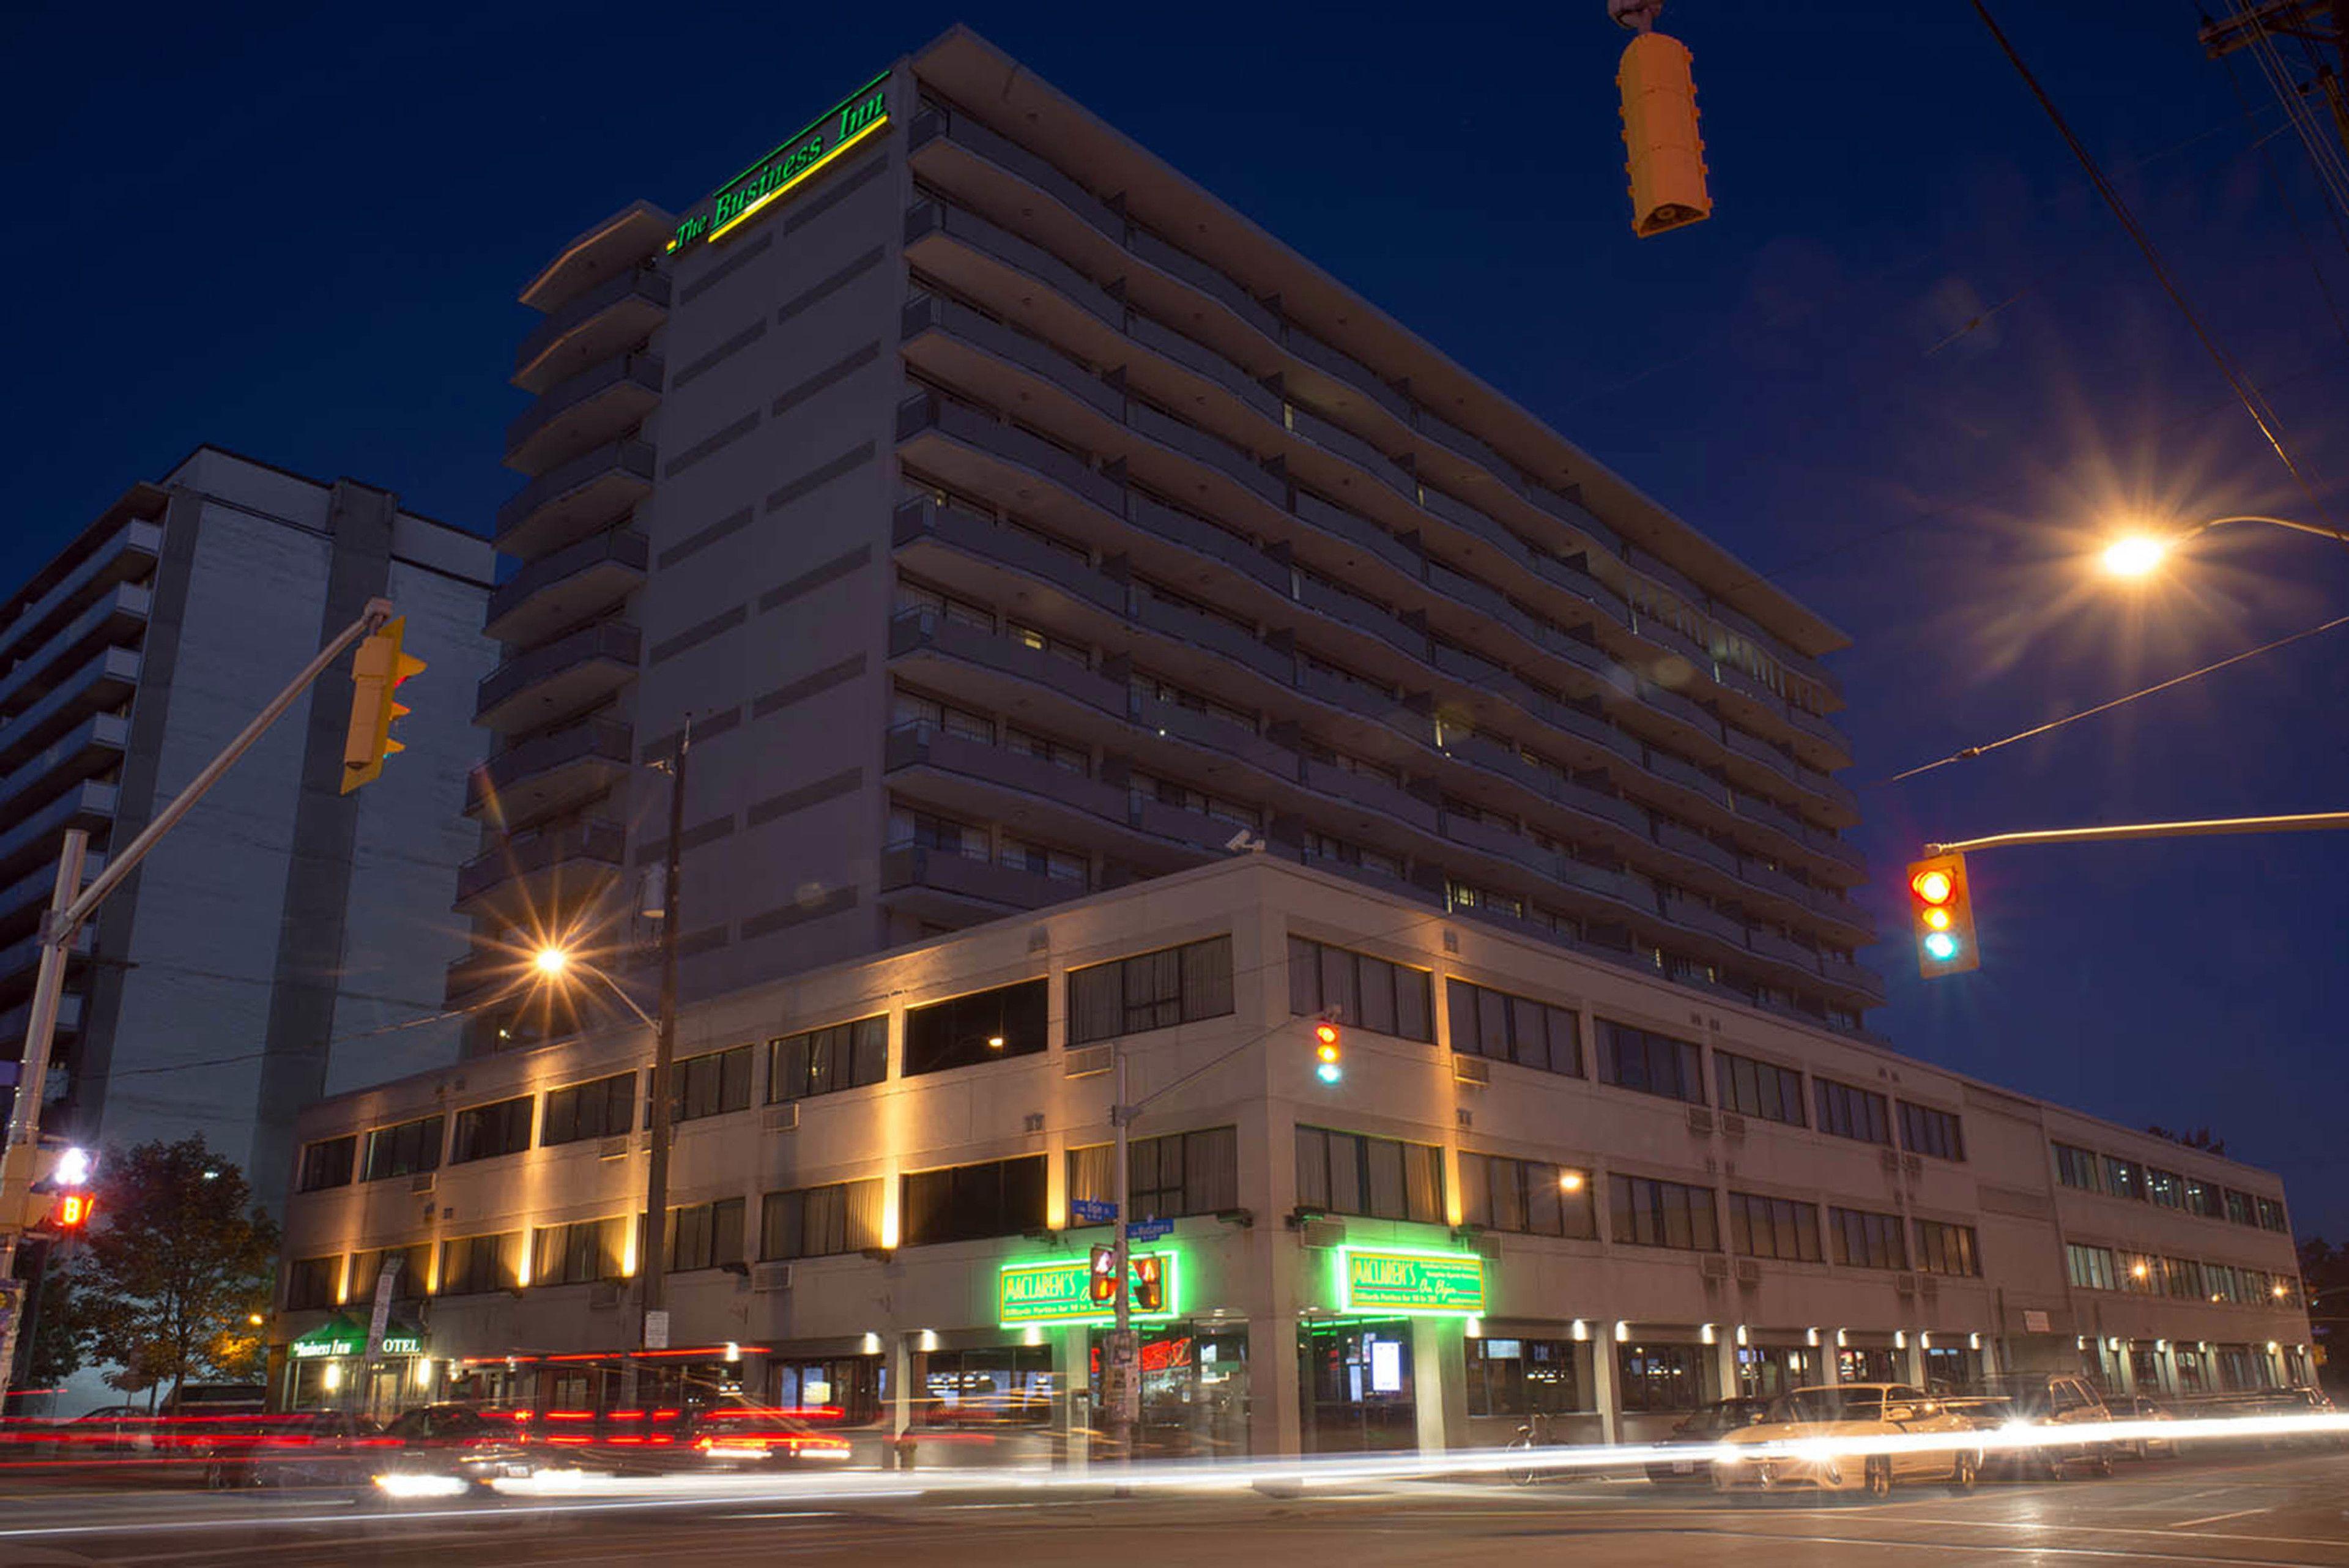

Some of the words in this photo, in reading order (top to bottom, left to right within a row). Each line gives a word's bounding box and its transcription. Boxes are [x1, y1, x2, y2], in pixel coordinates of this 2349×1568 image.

[676, 215, 708, 248] The
[712, 136, 822, 226] Business
[836, 92, 885, 141] Inn
[1005, 1271, 1076, 1301] MACLAREN'S
[1355, 1260, 1416, 1286] MACLAREN'S
[382, 1339, 421, 1353] OTEL
